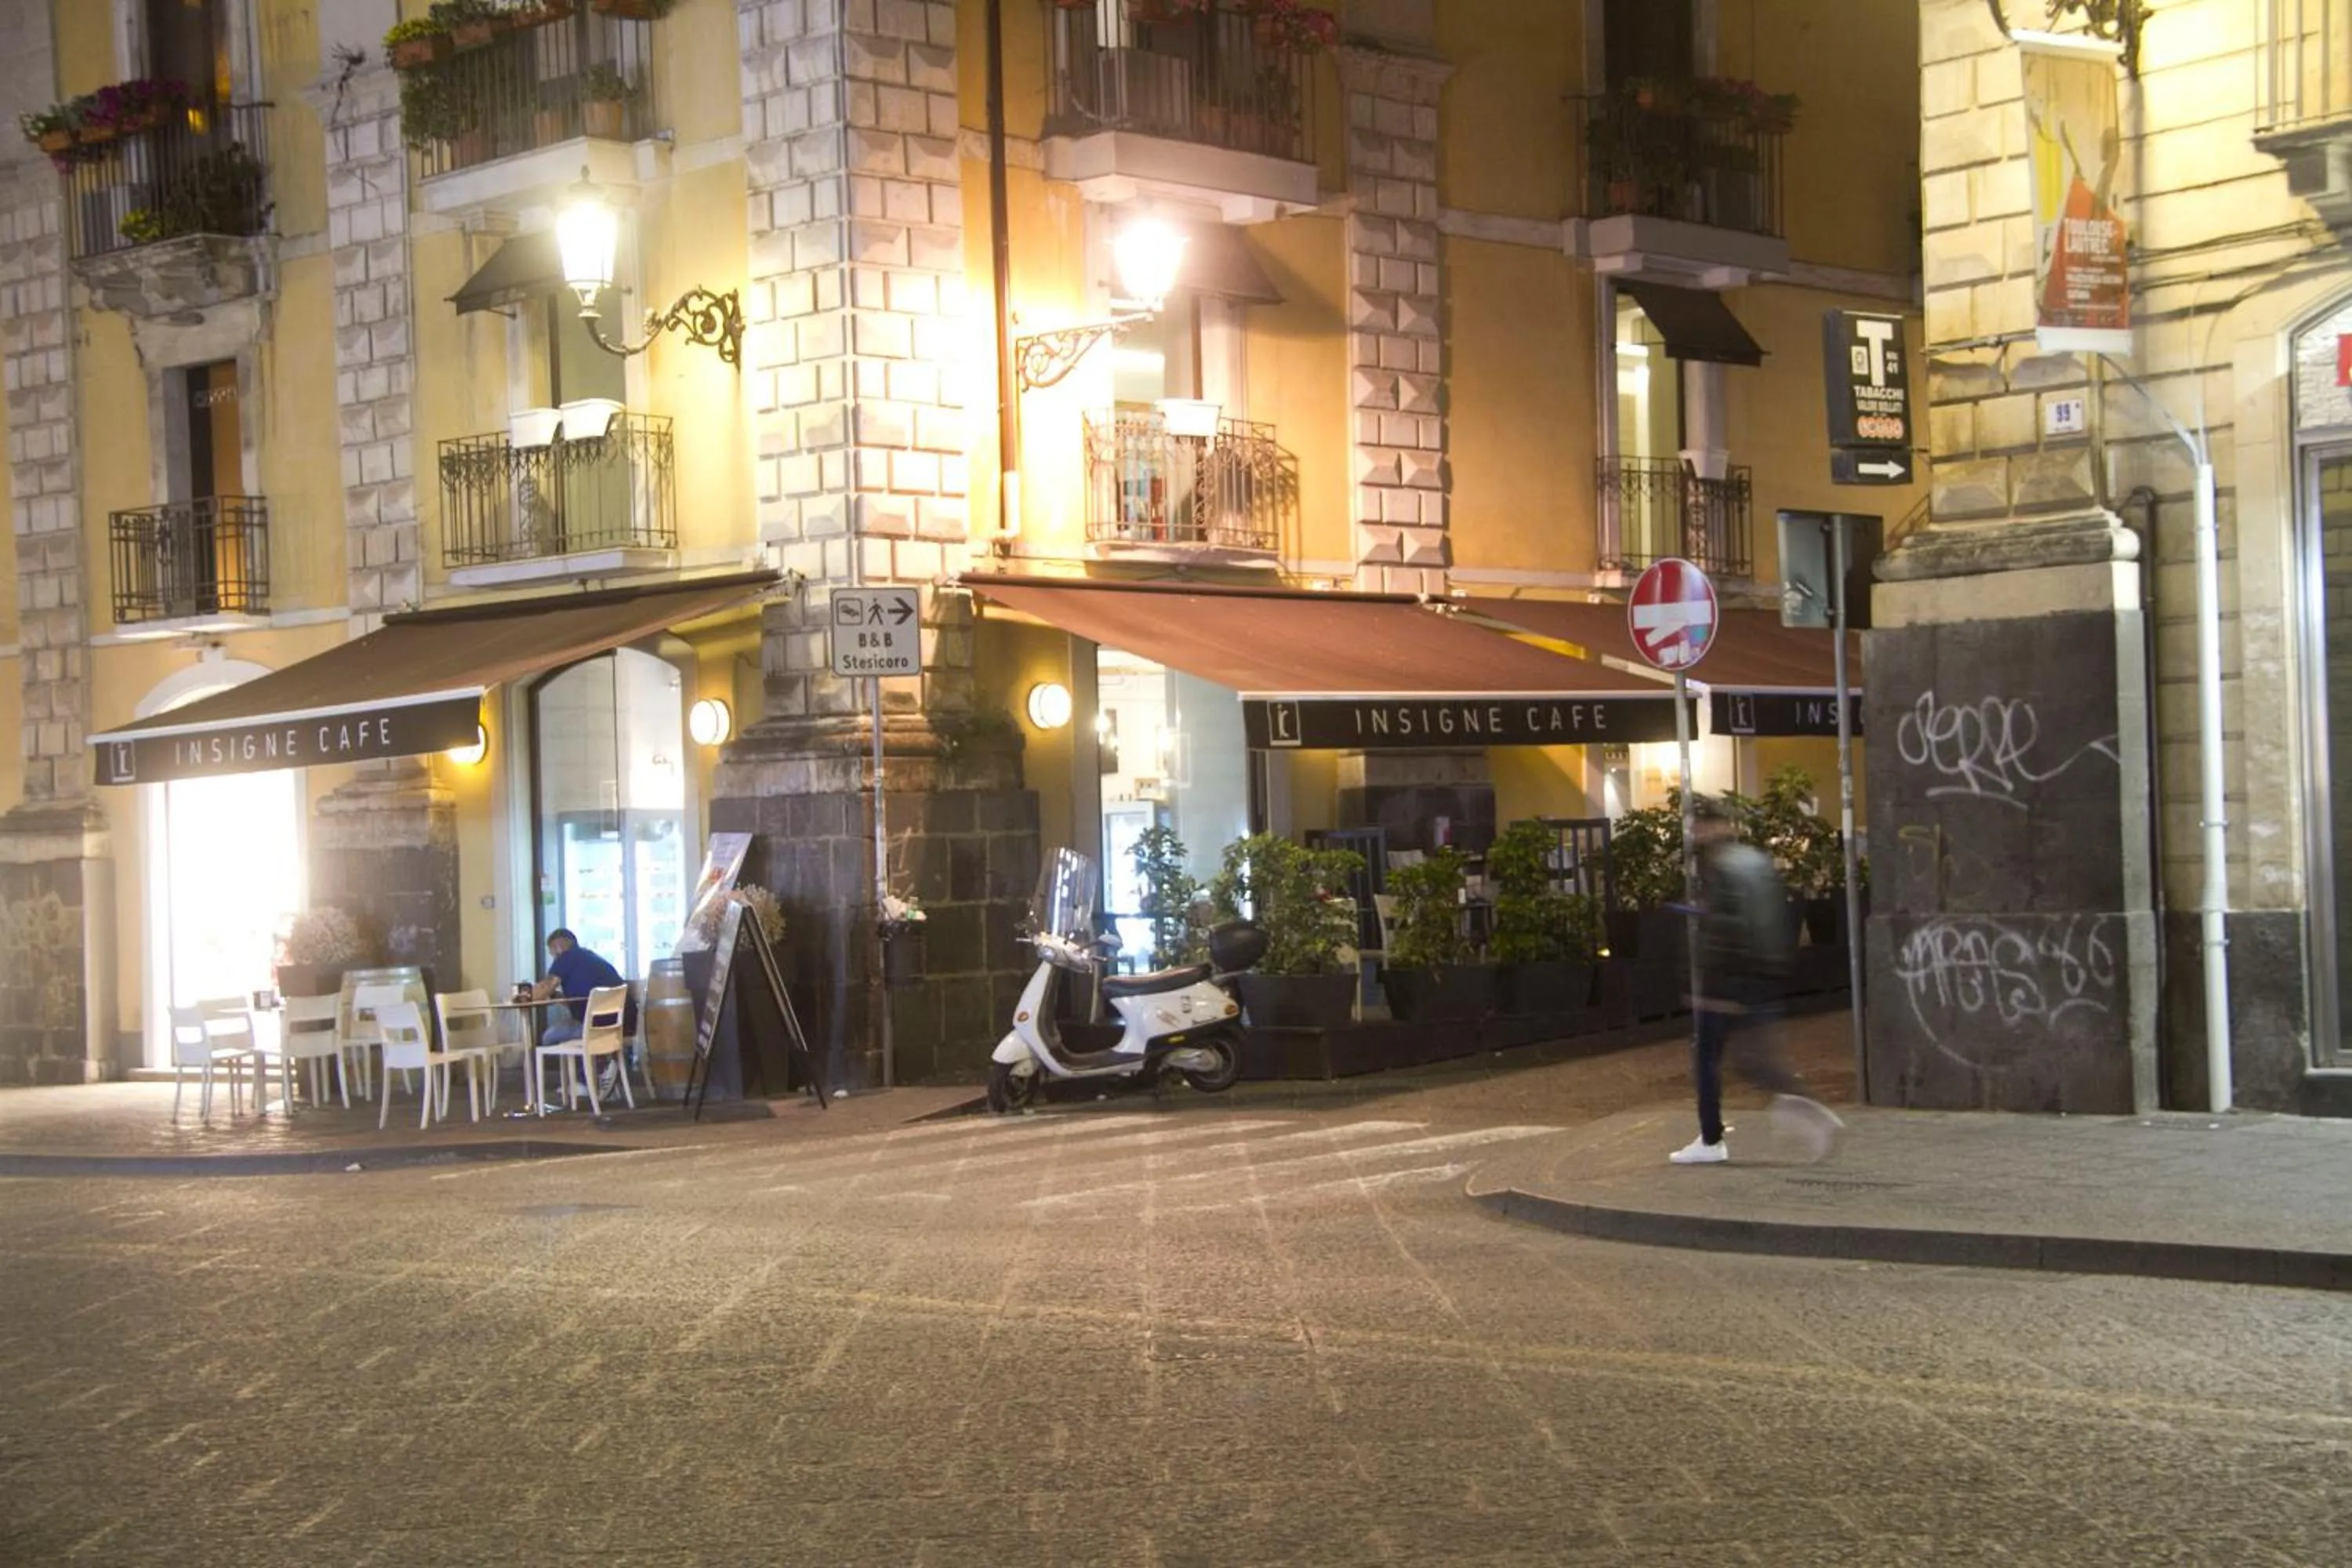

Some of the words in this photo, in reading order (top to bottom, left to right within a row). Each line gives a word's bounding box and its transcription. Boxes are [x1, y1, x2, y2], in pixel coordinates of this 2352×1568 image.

[1856, 319, 1893, 387] T
[1853, 385, 1905, 401] TABACCHI
[843, 654, 909, 669] Stesicoro
[1355, 707, 1504, 734] INSIGNE
[1526, 705, 1607, 731] CAFE
[176, 730, 297, 766] INSIGNE
[318, 717, 391, 753] CAFE
